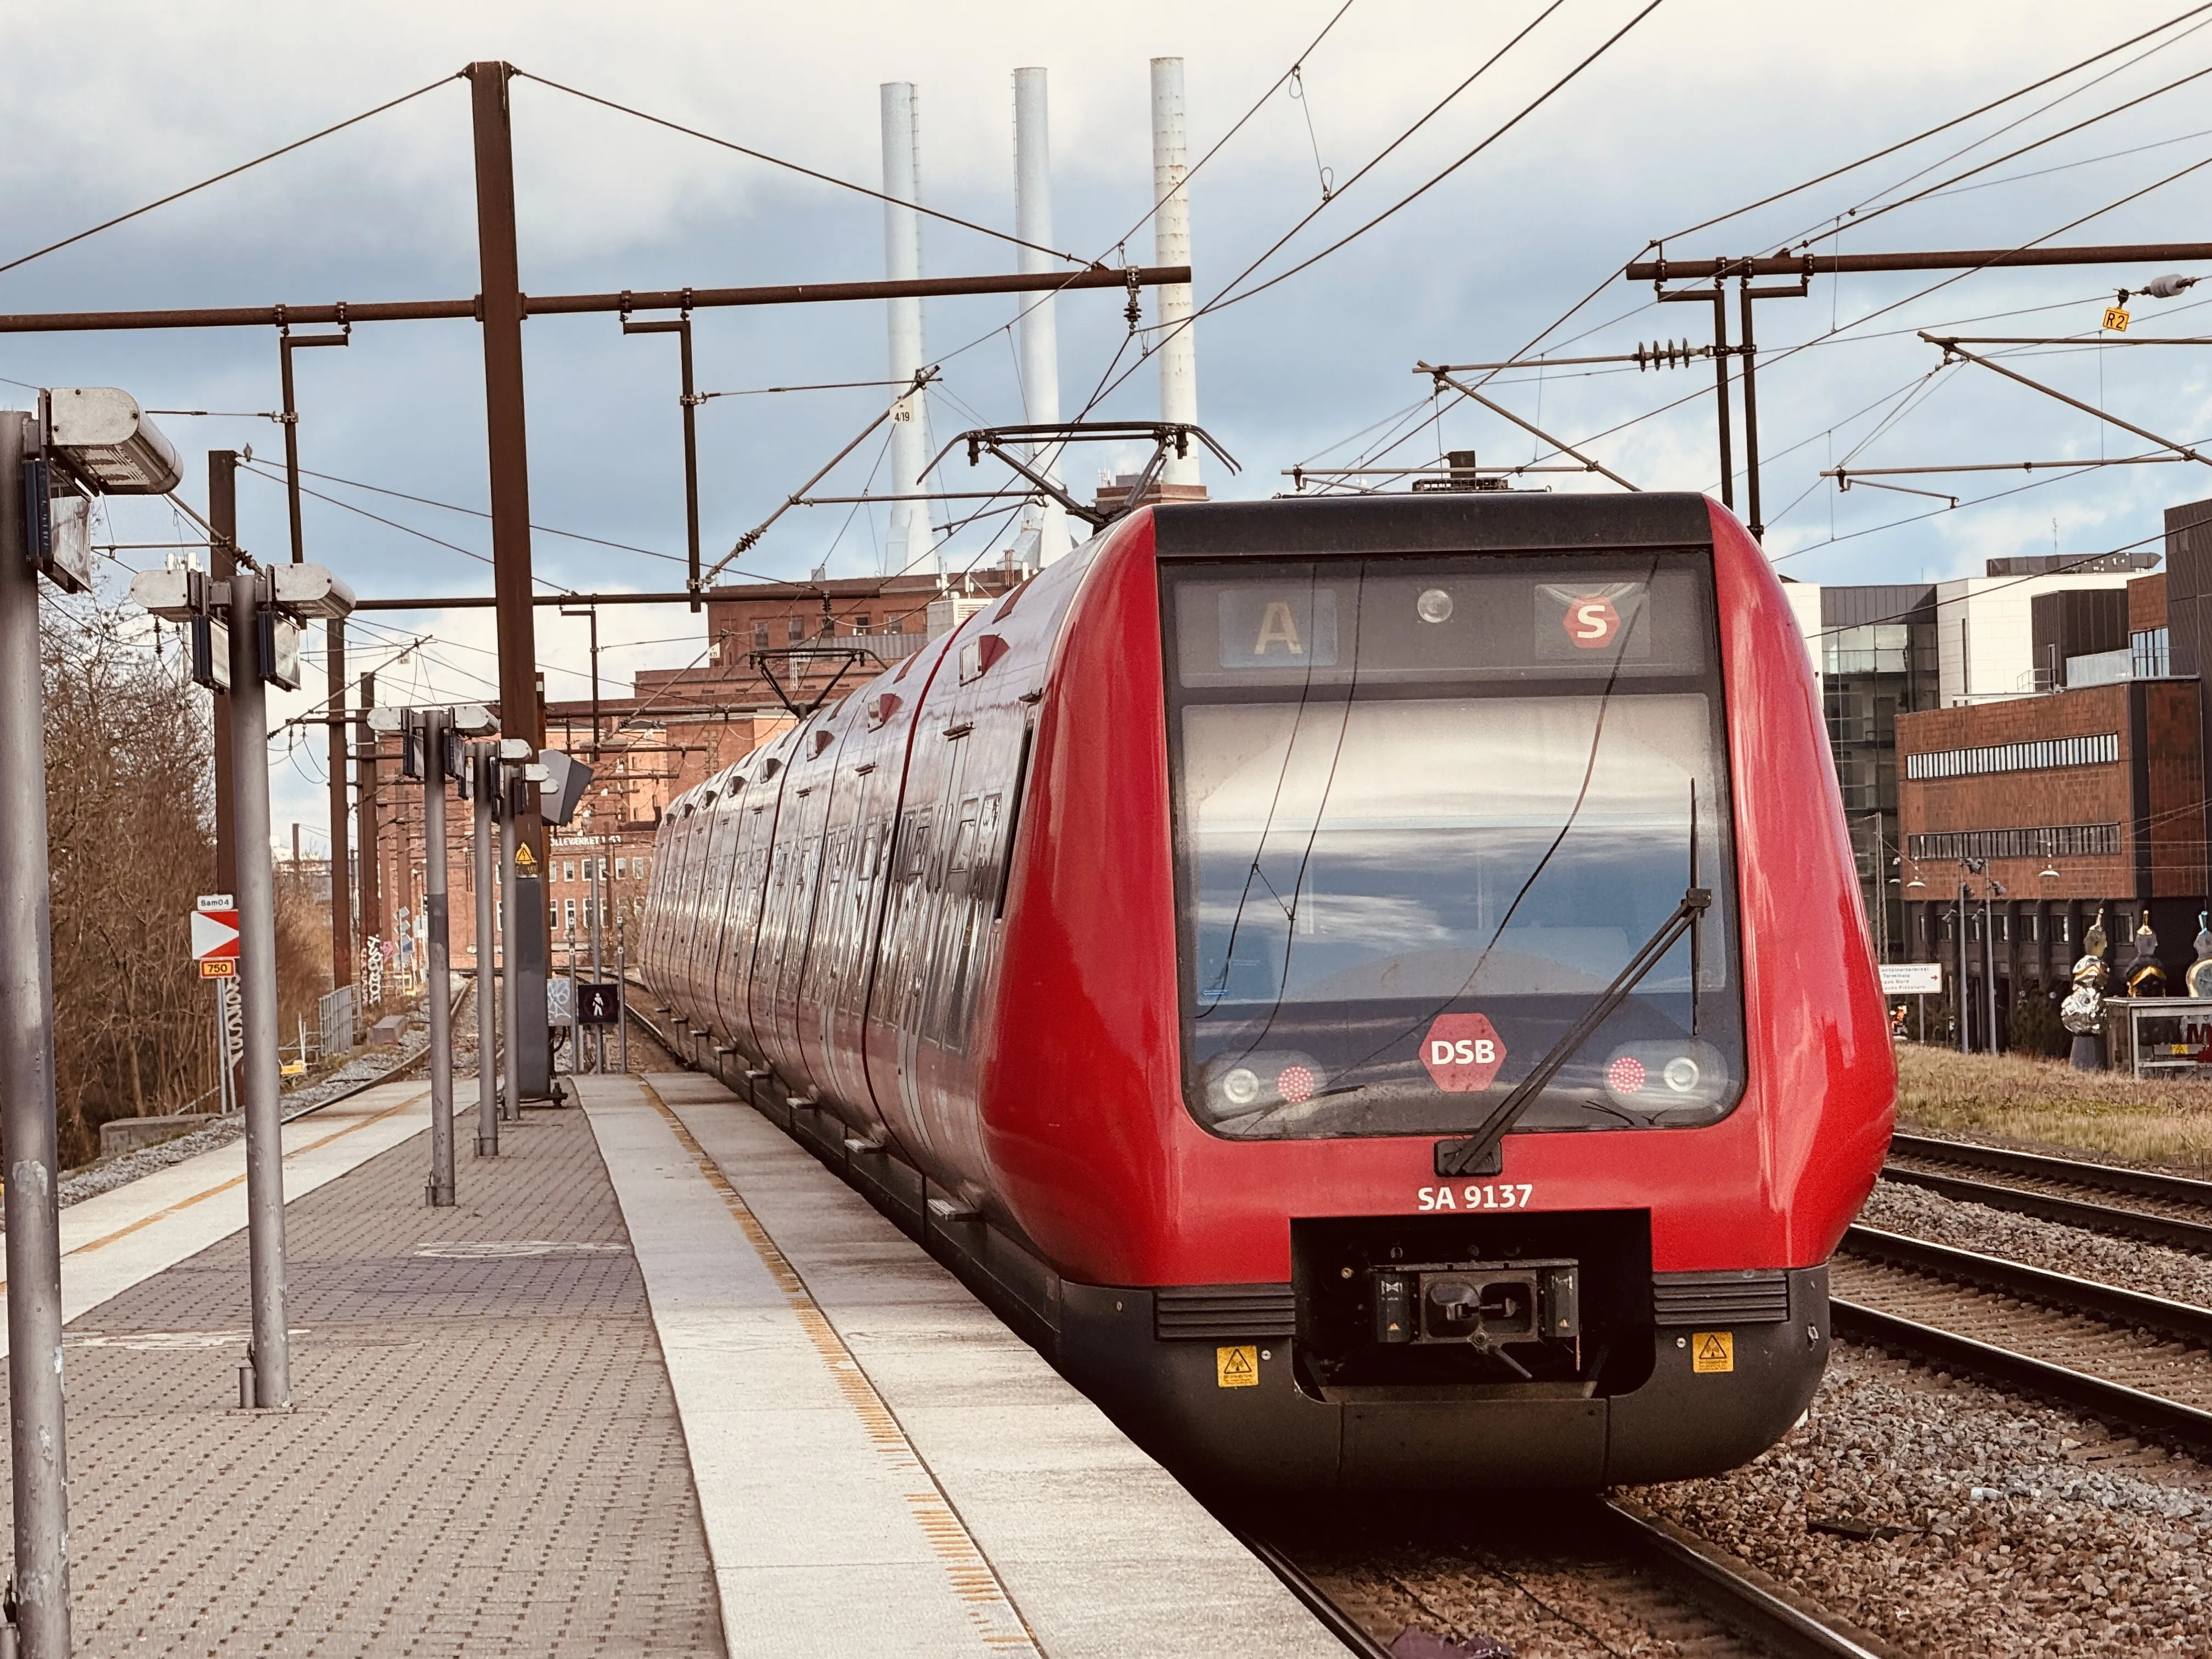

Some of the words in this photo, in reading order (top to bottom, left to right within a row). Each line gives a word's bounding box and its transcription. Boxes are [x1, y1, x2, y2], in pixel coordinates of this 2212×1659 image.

[2106, 312, 2125, 329] R2
[895, 411, 910, 422] 4/19
[1254, 602, 1304, 654] A
[1576, 605, 1608, 639] S
[602, 836, 621, 844] 153
[208, 964, 228, 973] 750
[1431, 1039, 1496, 1065] DSB
[1418, 1185, 1457, 1211] SA
[1465, 1183, 1533, 1209] 9137
